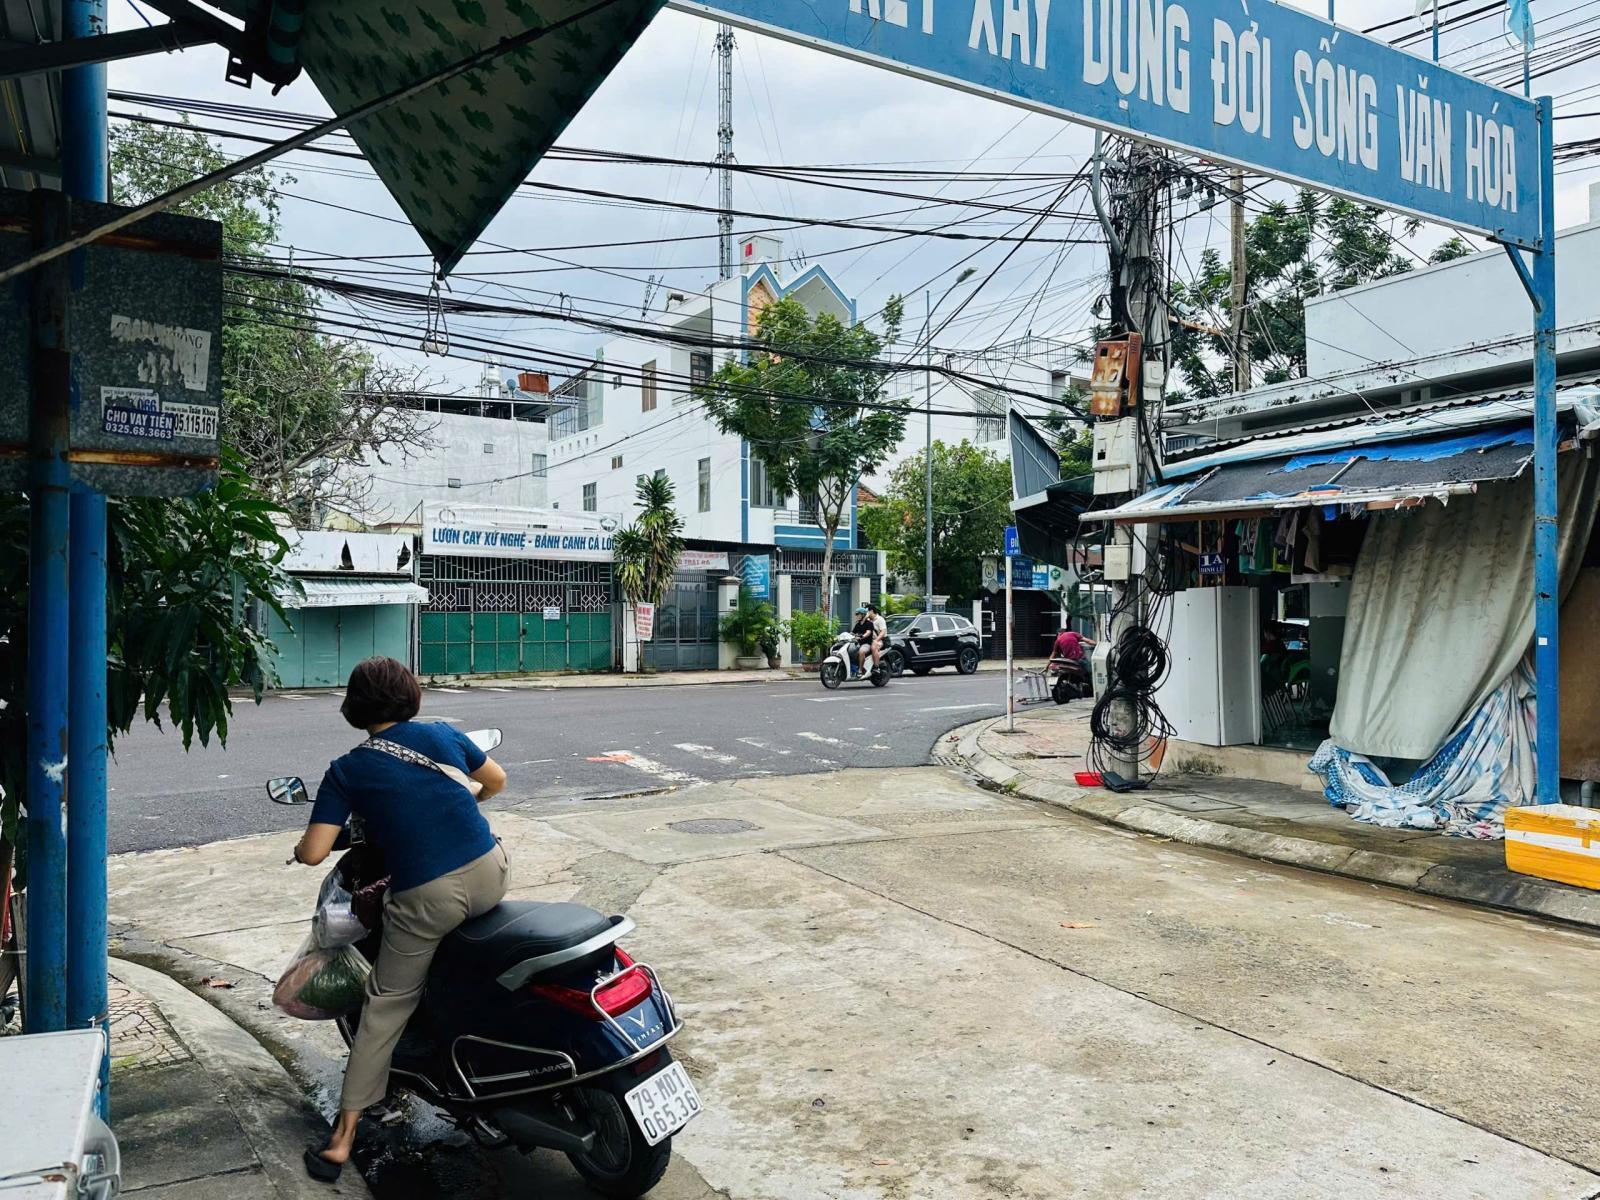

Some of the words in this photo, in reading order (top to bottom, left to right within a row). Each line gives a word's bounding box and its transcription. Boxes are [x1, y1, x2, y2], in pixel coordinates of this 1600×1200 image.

[1082, 0, 1191, 114] DỤNG
[1210, 0, 1272, 139] ĐỜI
[1292, 30, 1379, 171] SỐNG
[1396, 73, 1452, 194] VĂN
[1465, 101, 1518, 214] HÓA
[106, 409, 128, 424] CHO
[130, 412, 149, 427] VAY
[105, 422, 172, 439] 0325.68.3663
[463, 530, 482, 545] CAY
[484, 529, 500, 546] XỨ
[534, 532, 561, 549] BÁNH
[562, 536, 587, 550] CANH
[588, 534, 600, 551] CÁ
[1201, 554, 1223, 567] 1A
[631, 1067, 685, 1116] 79-MD1
[643, 1090, 698, 1139] 065.36
